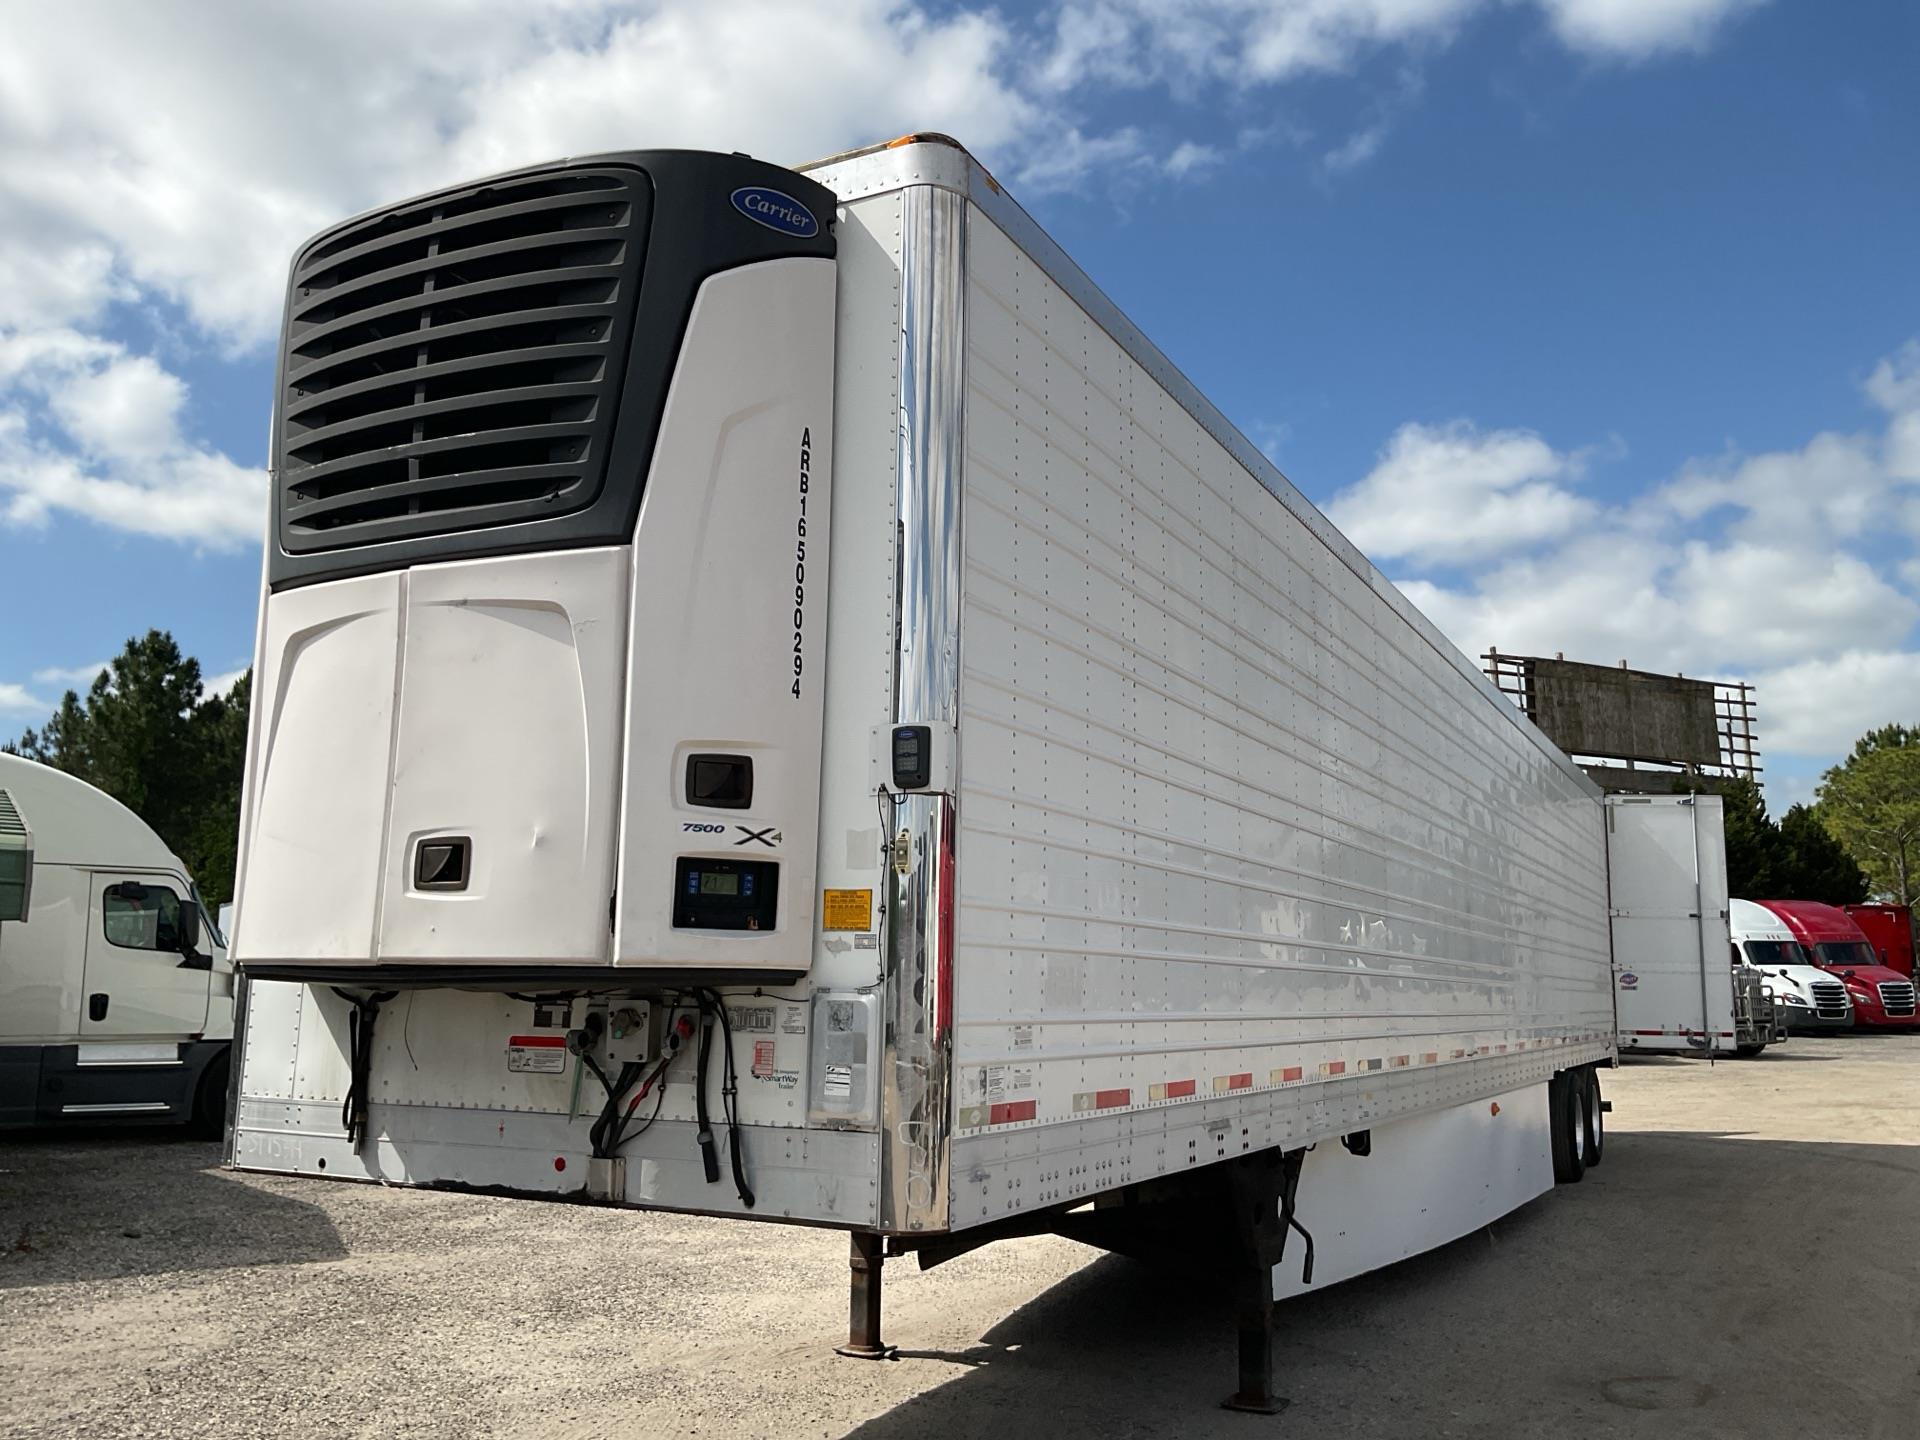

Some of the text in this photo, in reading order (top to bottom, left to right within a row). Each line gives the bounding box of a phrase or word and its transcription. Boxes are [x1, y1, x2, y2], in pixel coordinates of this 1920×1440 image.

[744, 194, 810, 228] Carrier
[792, 427, 811, 699] ARB165090294
[683, 823, 726, 834] 7500
